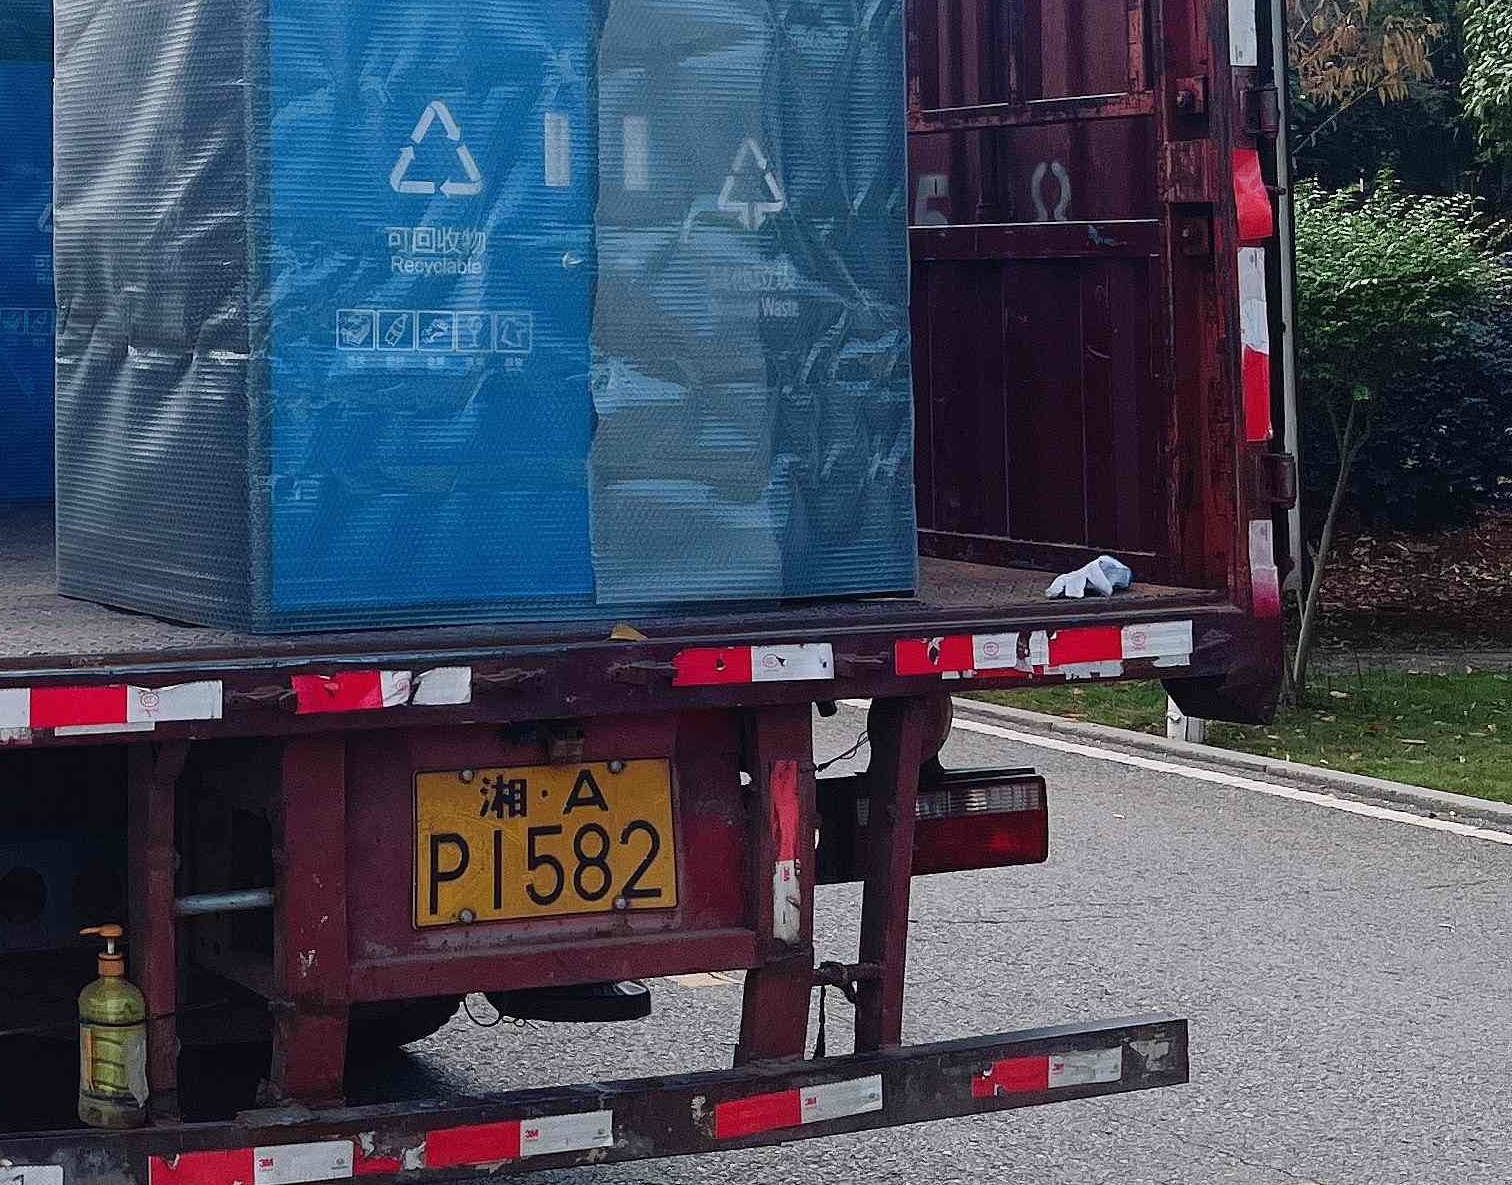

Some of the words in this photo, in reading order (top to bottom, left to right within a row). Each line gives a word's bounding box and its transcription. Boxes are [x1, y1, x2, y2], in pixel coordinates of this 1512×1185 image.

[385, 226, 486, 254] 可回收物
[391, 255, 483, 277] Recyclable
[429, 819, 662, 915] P1582
